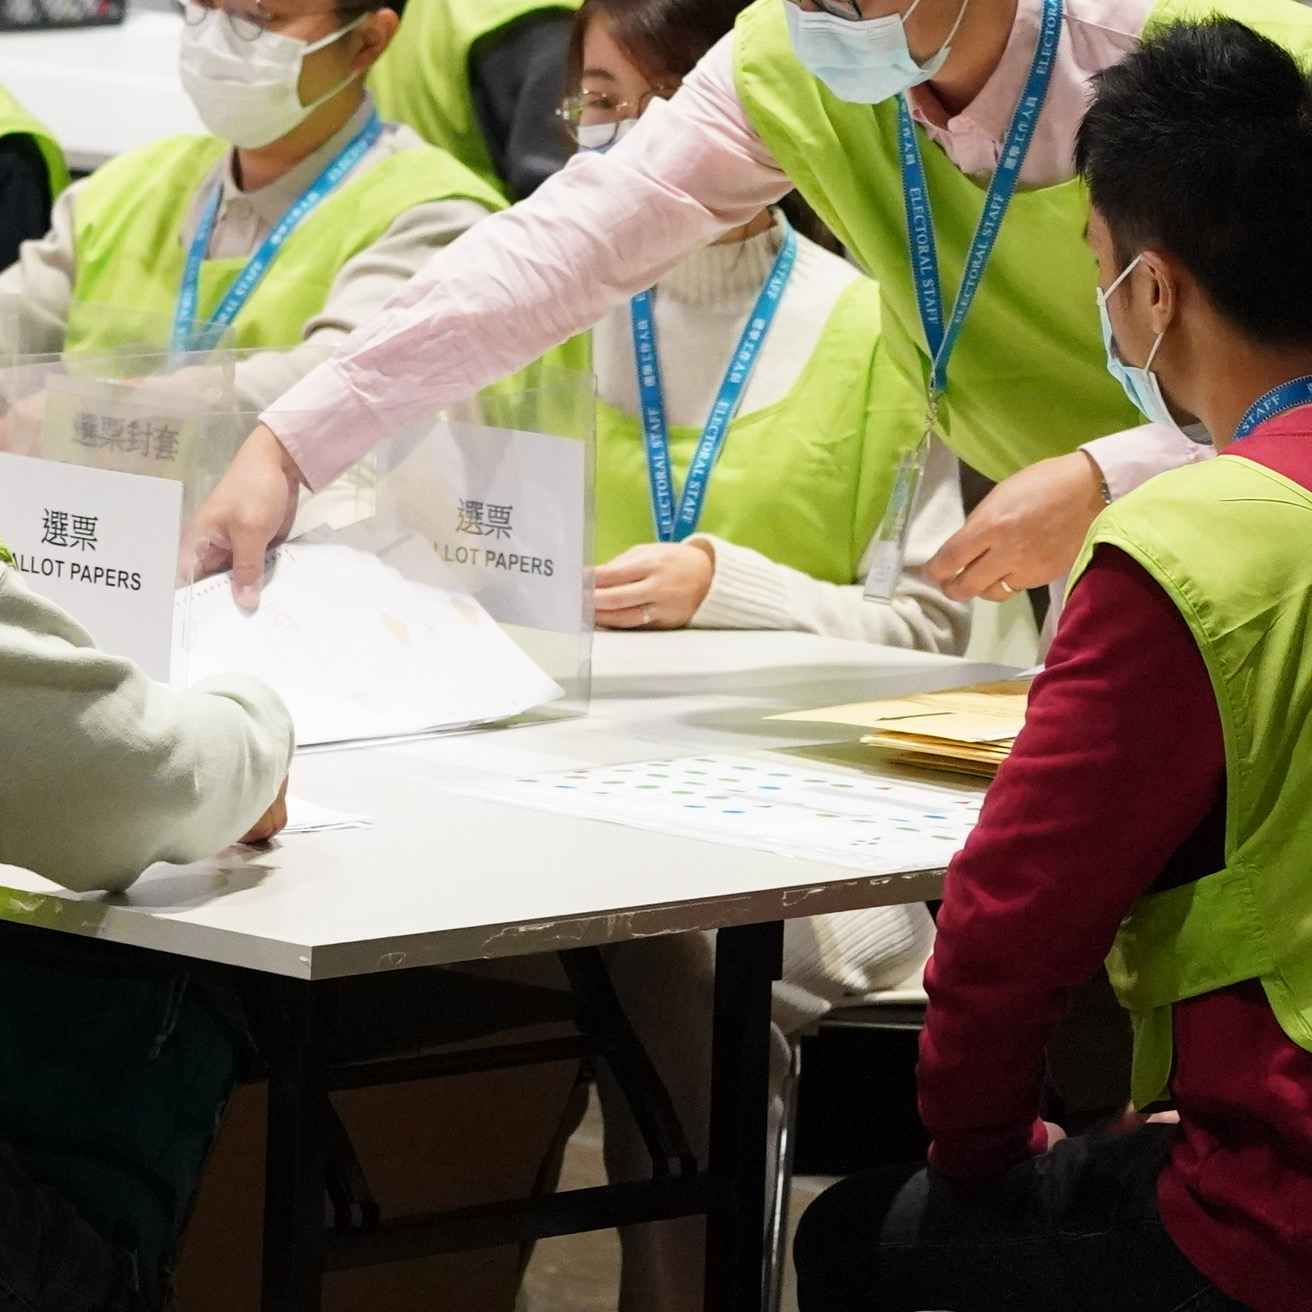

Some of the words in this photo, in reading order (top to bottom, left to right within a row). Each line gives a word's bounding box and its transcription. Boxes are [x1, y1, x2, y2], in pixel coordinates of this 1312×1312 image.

[909, 188, 933, 276] ELECTORAL
[923, 279, 939, 325] STAFF
[954, 241, 989, 324] ELECTORAL
[982, 192, 1005, 237] STAFF
[1241, 394, 1280, 433] STAFF
[75, 413, 180, 462] 選票封套
[692, 401, 730, 478] ELECTORAL
[41, 508, 99, 551] 選票
[456, 498, 514, 540] 選票
[70, 562, 142, 591] PAPERS
[434, 542, 481, 565] LOT
[485, 549, 554, 577] PAPERS
